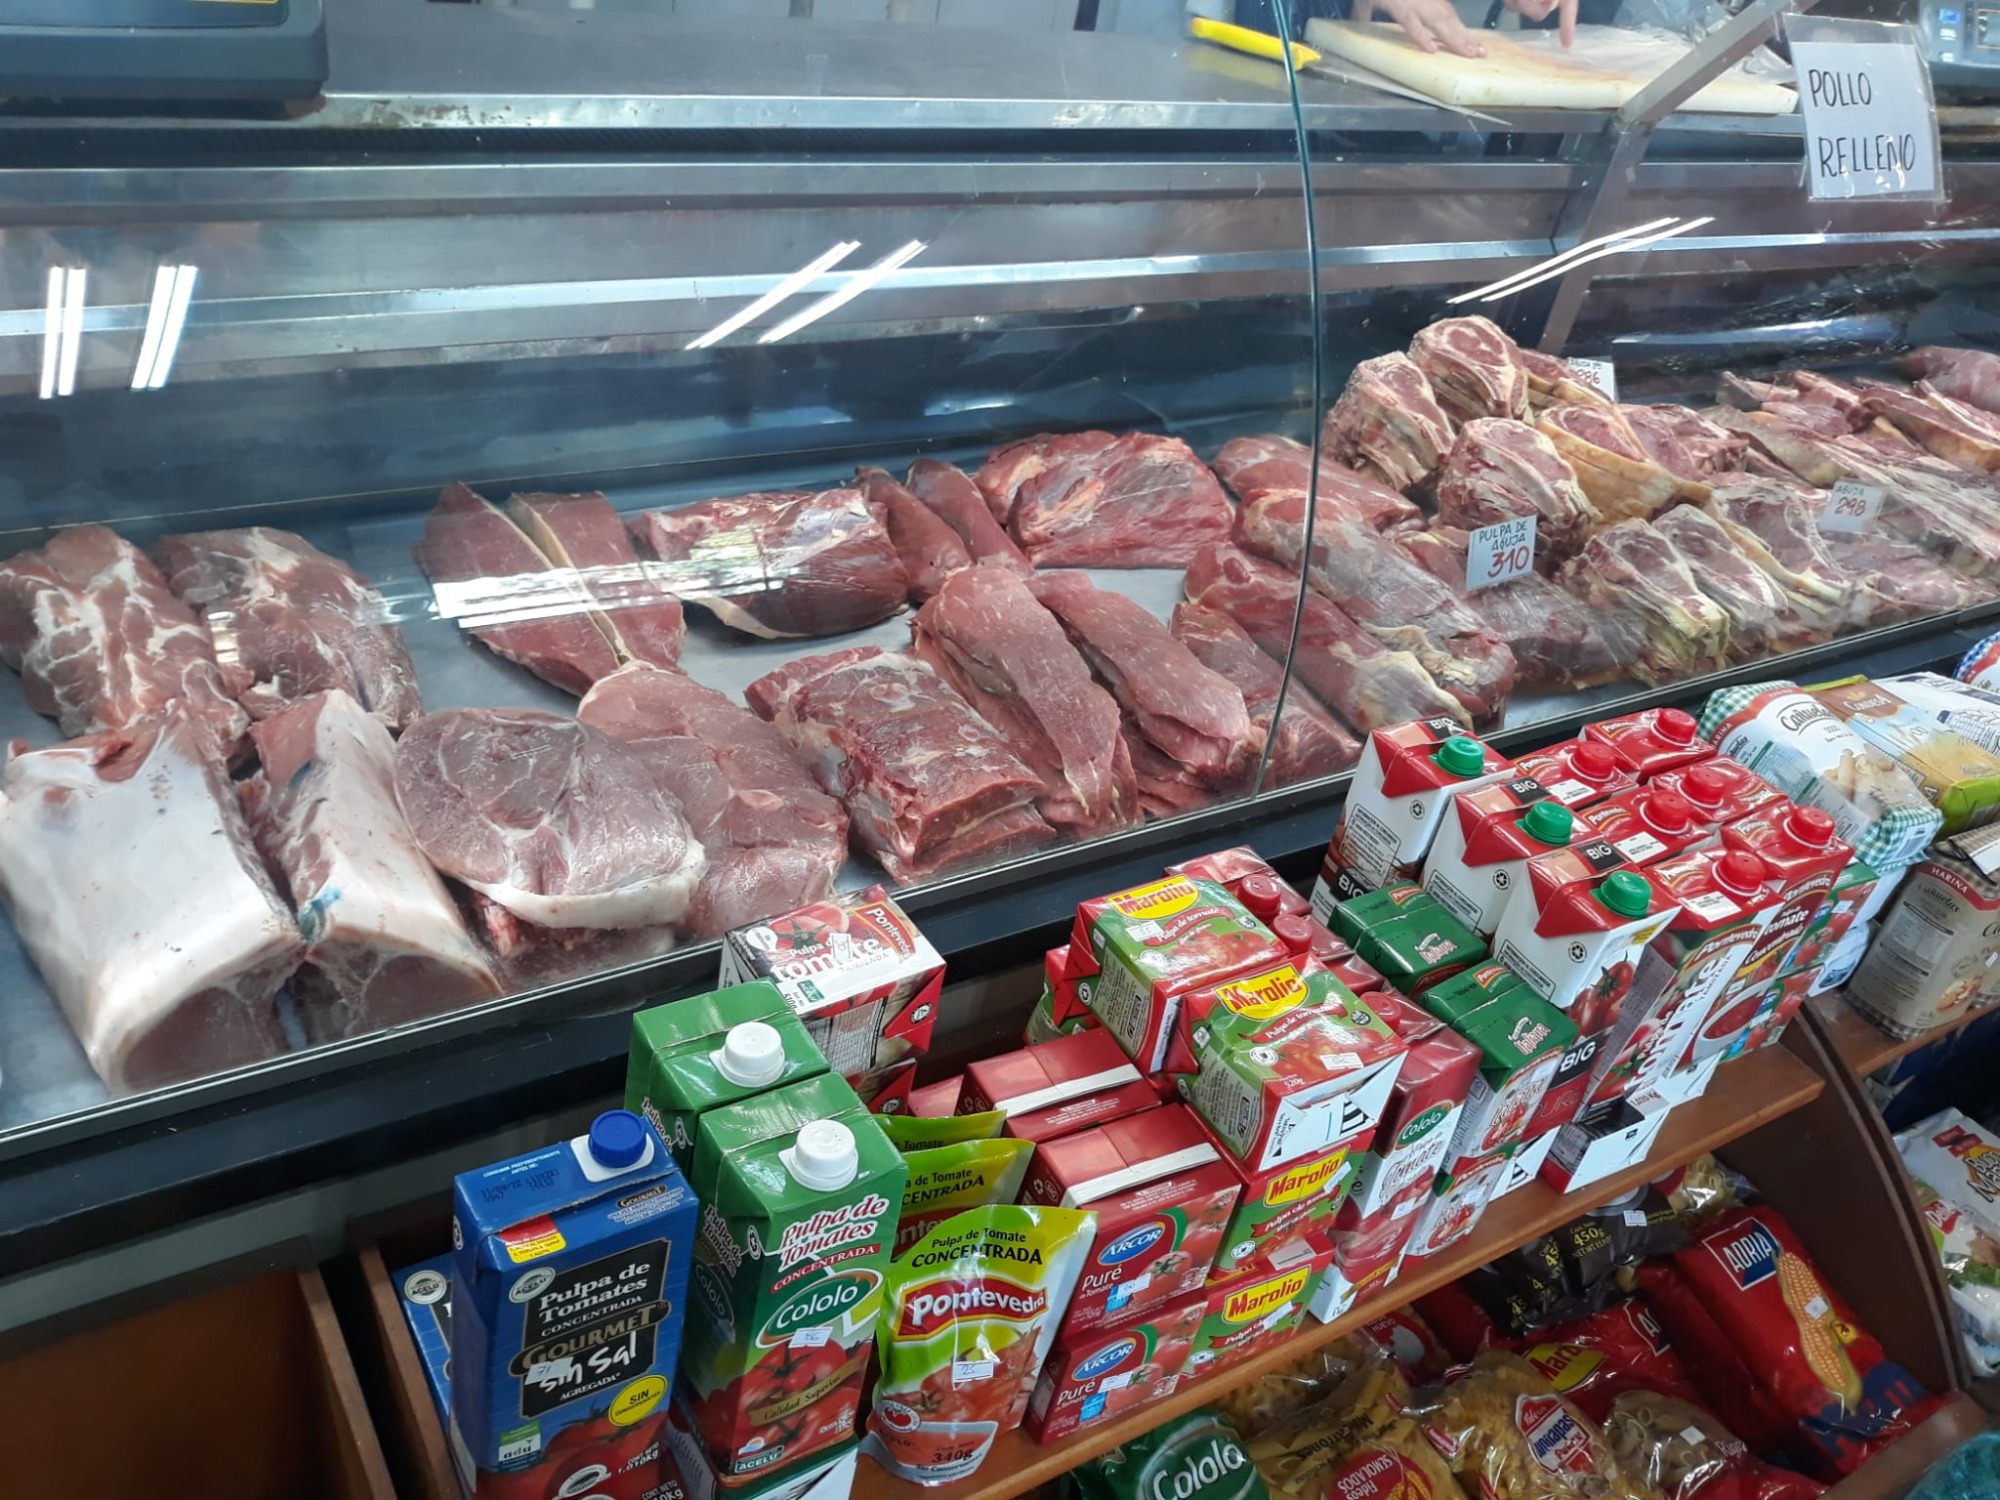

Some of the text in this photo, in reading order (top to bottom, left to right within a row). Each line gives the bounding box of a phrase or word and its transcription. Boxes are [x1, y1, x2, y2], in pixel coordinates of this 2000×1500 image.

[1808, 68, 1872, 107] POLLO
[1818, 133, 1916, 178] RELLENO
[1834, 496, 1866, 517] 298
[1478, 520, 1528, 543] PULPA DE
[1491, 532, 1526, 551] AGUJA
[1487, 545, 1530, 578] 310
[1429, 717, 1454, 730] BIG
[1711, 722, 1734, 749] ARINA
[1512, 780, 1538, 794] BIG
[1586, 843, 1612, 860] BIG
[1931, 866, 1968, 894] HARINA
[1113, 881, 1196, 915] Marolio
[770, 937, 884, 982] tomte
[1221, 975, 1303, 1011] Marolio
[1559, 1041, 1597, 1073] BIG
[643, 1098, 666, 1141] Pulpa
[1401, 1111, 1443, 1140] Cololo
[903, 1139, 945, 1149] Tomate
[901, 1174, 985, 1206] CENTRADA
[915, 1169, 973, 1187] de Tomate
[1269, 1157, 1340, 1201] Marolio
[620, 1185, 664, 1208] GOURMET
[704, 1204, 733, 1249] Pulpa
[781, 1194, 889, 1248] Pulpa de
[779, 1220, 876, 1270] Tomates
[931, 1227, 1027, 1249] Pulpa de Tomate
[1103, 1228, 1163, 1259] ARCOR
[1722, 1231, 1773, 1274] ADRIA
[773, 1245, 875, 1292] CONCENTRADA
[911, 1243, 1043, 1268] CONCENTRADA
[411, 1282, 440, 1296] ACELU
[515, 1273, 549, 1297] ACELU
[539, 1263, 651, 1311] Pulpa de
[694, 1264, 726, 1317] Cololo
[1081, 1263, 1122, 1291] Puré
[1086, 1282, 1114, 1297] Tomate
[539, 1278, 649, 1324] Tomates
[776, 1283, 858, 1329] Cololo
[911, 1286, 1046, 1326] Pontevedra
[1228, 1278, 1304, 1318] Marolio
[541, 1295, 643, 1337] CONCENTRADA
[1371, 1317, 1397, 1333] HUEVO
[522, 1304, 657, 1369] GOURMET
[587, 1330, 638, 1374] Sal
[1077, 1343, 1133, 1375] ARCOR
[629, 1388, 650, 1405] SIN
[763, 1398, 800, 1421] Calidad
[804, 1376, 841, 1403] Superior
[1057, 1378, 1096, 1406] Puré
[738, 1451, 779, 1471] ACELU
[931, 1448, 974, 1464] 340g
[1153, 1439, 1246, 1500] Cololo
[659, 1479, 678, 1491] NETO
[1336, 1454, 1394, 1493] SEMOLADOS
[1345, 1481, 1380, 1500] Fideos
